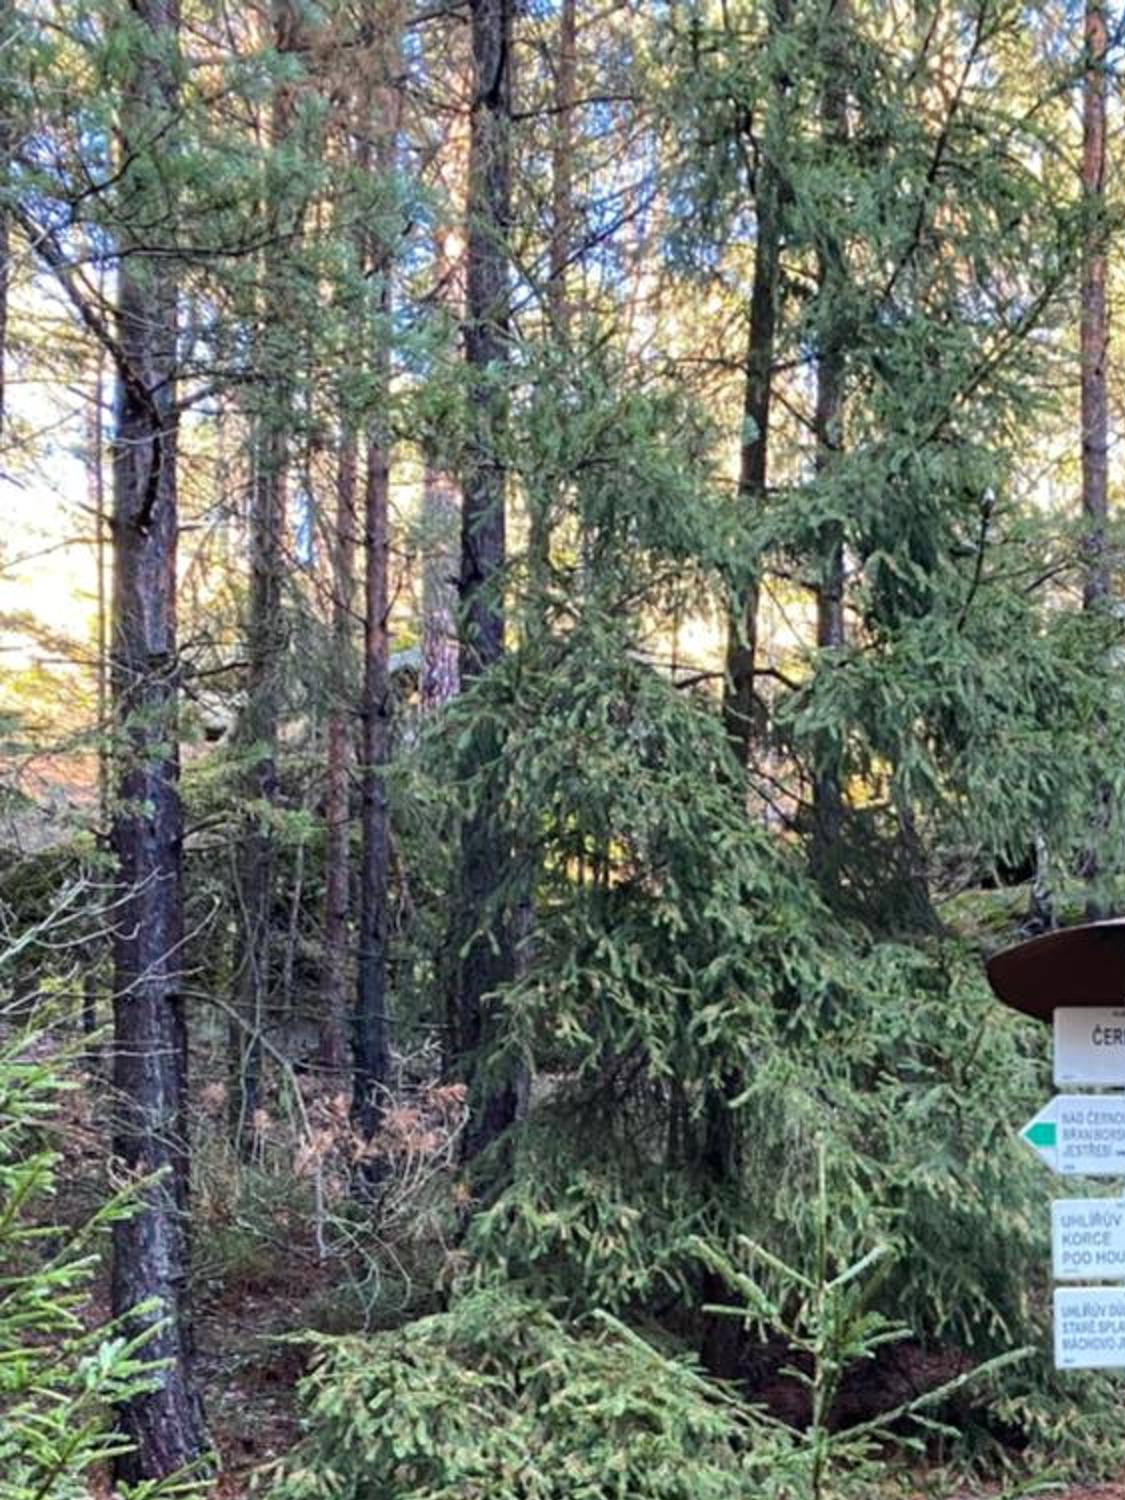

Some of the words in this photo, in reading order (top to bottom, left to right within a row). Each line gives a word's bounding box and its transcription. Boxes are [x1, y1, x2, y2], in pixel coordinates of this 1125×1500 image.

[1061, 1111, 1083, 1124] NAD
[1062, 1142, 1112, 1158] JESTŘEBÍ
[1060, 1210, 1121, 1228] UHLÍŘŮV
[1062, 1231, 1112, 1246] KORCE
[1062, 1250, 1092, 1265] POD
